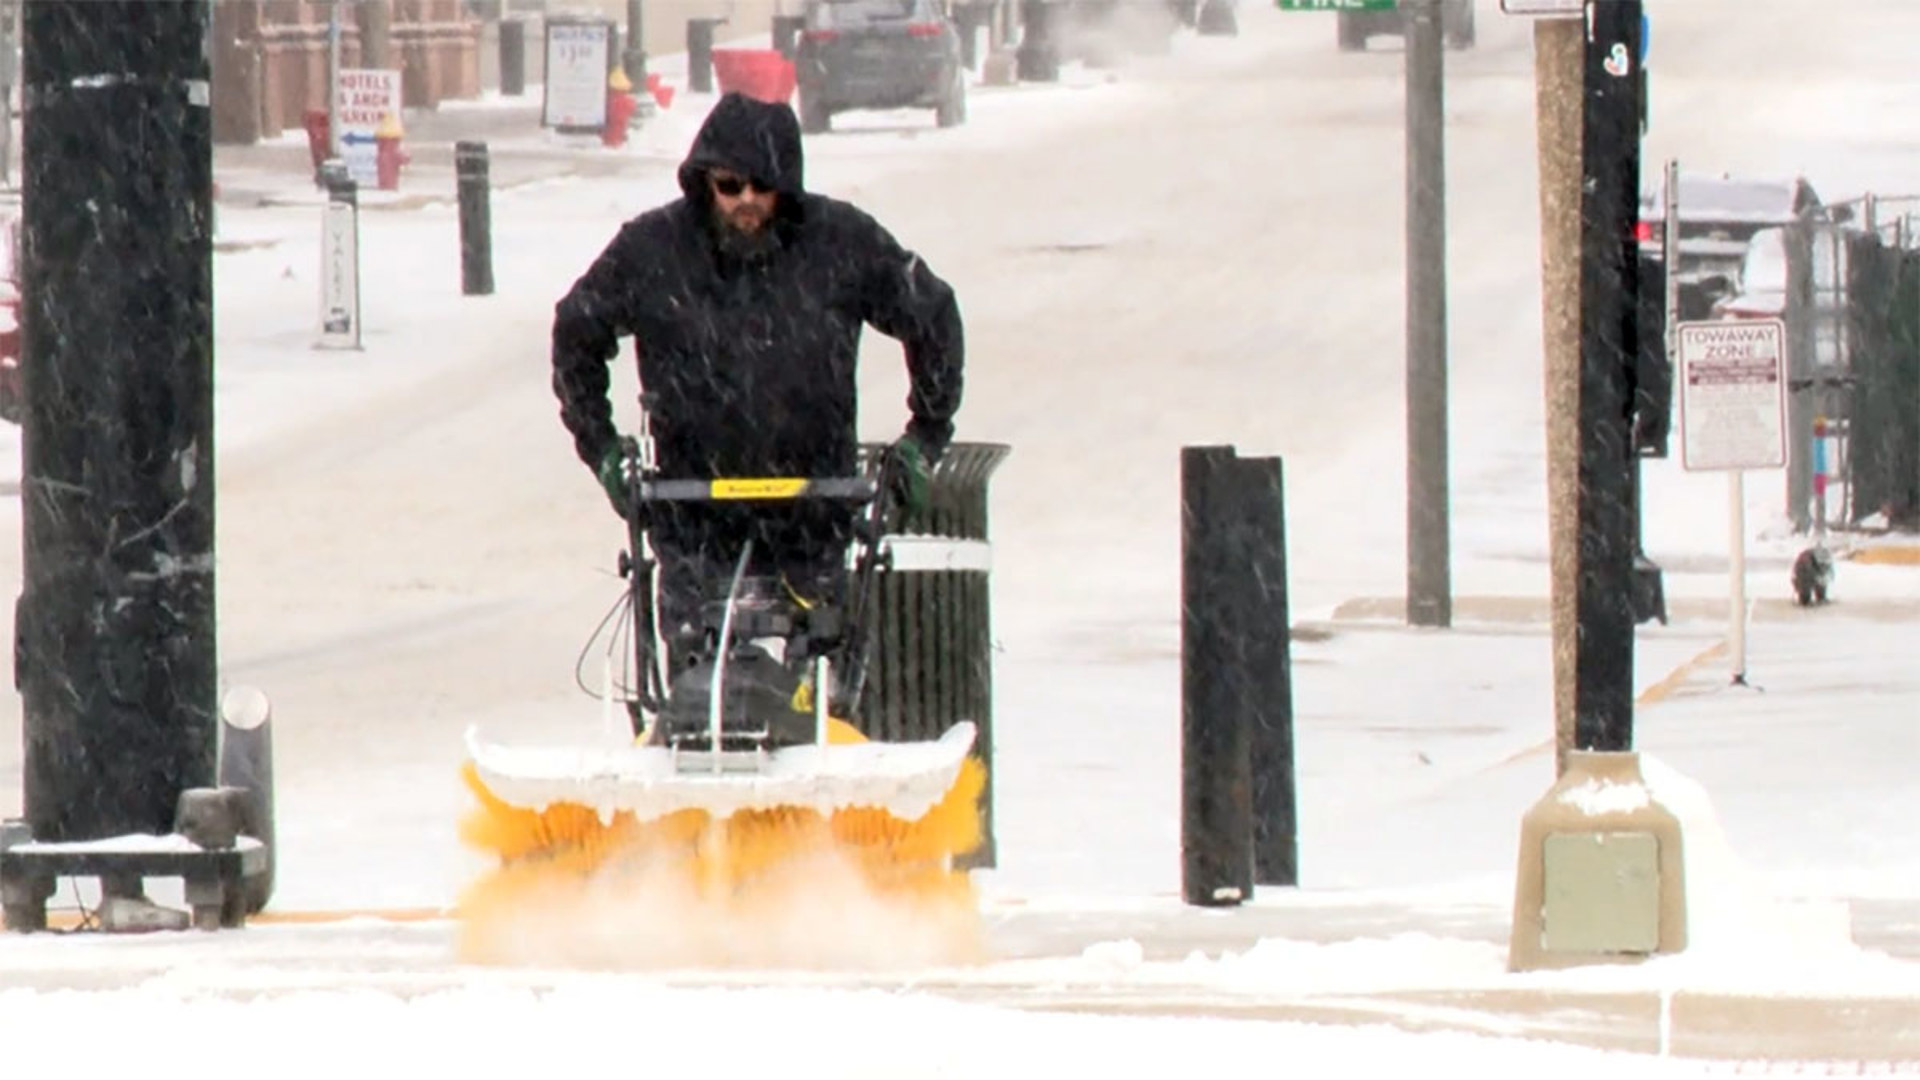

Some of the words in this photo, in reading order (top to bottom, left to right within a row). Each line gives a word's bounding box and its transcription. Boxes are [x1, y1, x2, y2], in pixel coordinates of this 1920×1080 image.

[340, 74, 391, 89] HOTELS
[353, 92, 390, 106] ARCH
[340, 111, 386, 124] ARKIN
[1685, 329, 1775, 343] TOWAWAY
[1704, 345, 1755, 358] ZONE
